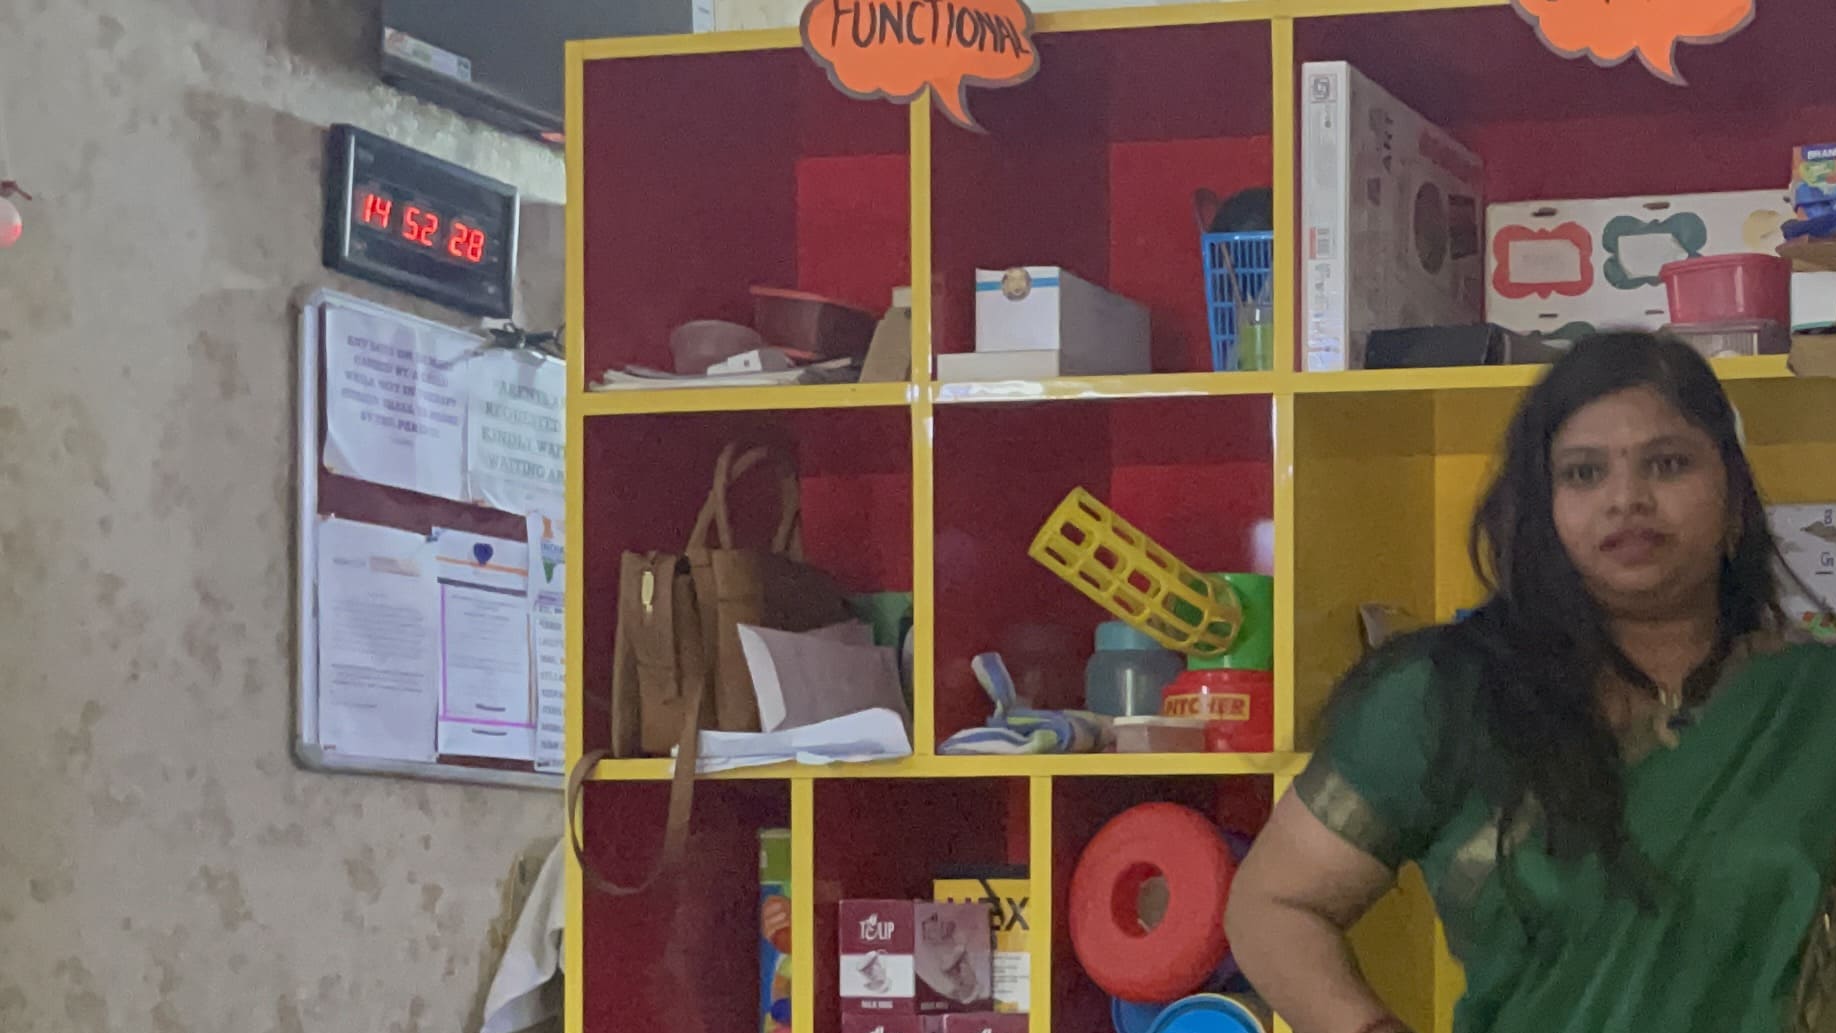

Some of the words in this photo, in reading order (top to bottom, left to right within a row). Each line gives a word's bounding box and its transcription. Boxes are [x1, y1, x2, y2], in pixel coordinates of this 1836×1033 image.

[832, 0, 1031, 58] FUNCTIONAL
[363, 193, 393, 229] 14
[402, 206, 439, 247] 52
[448, 221, 485, 262] 28
